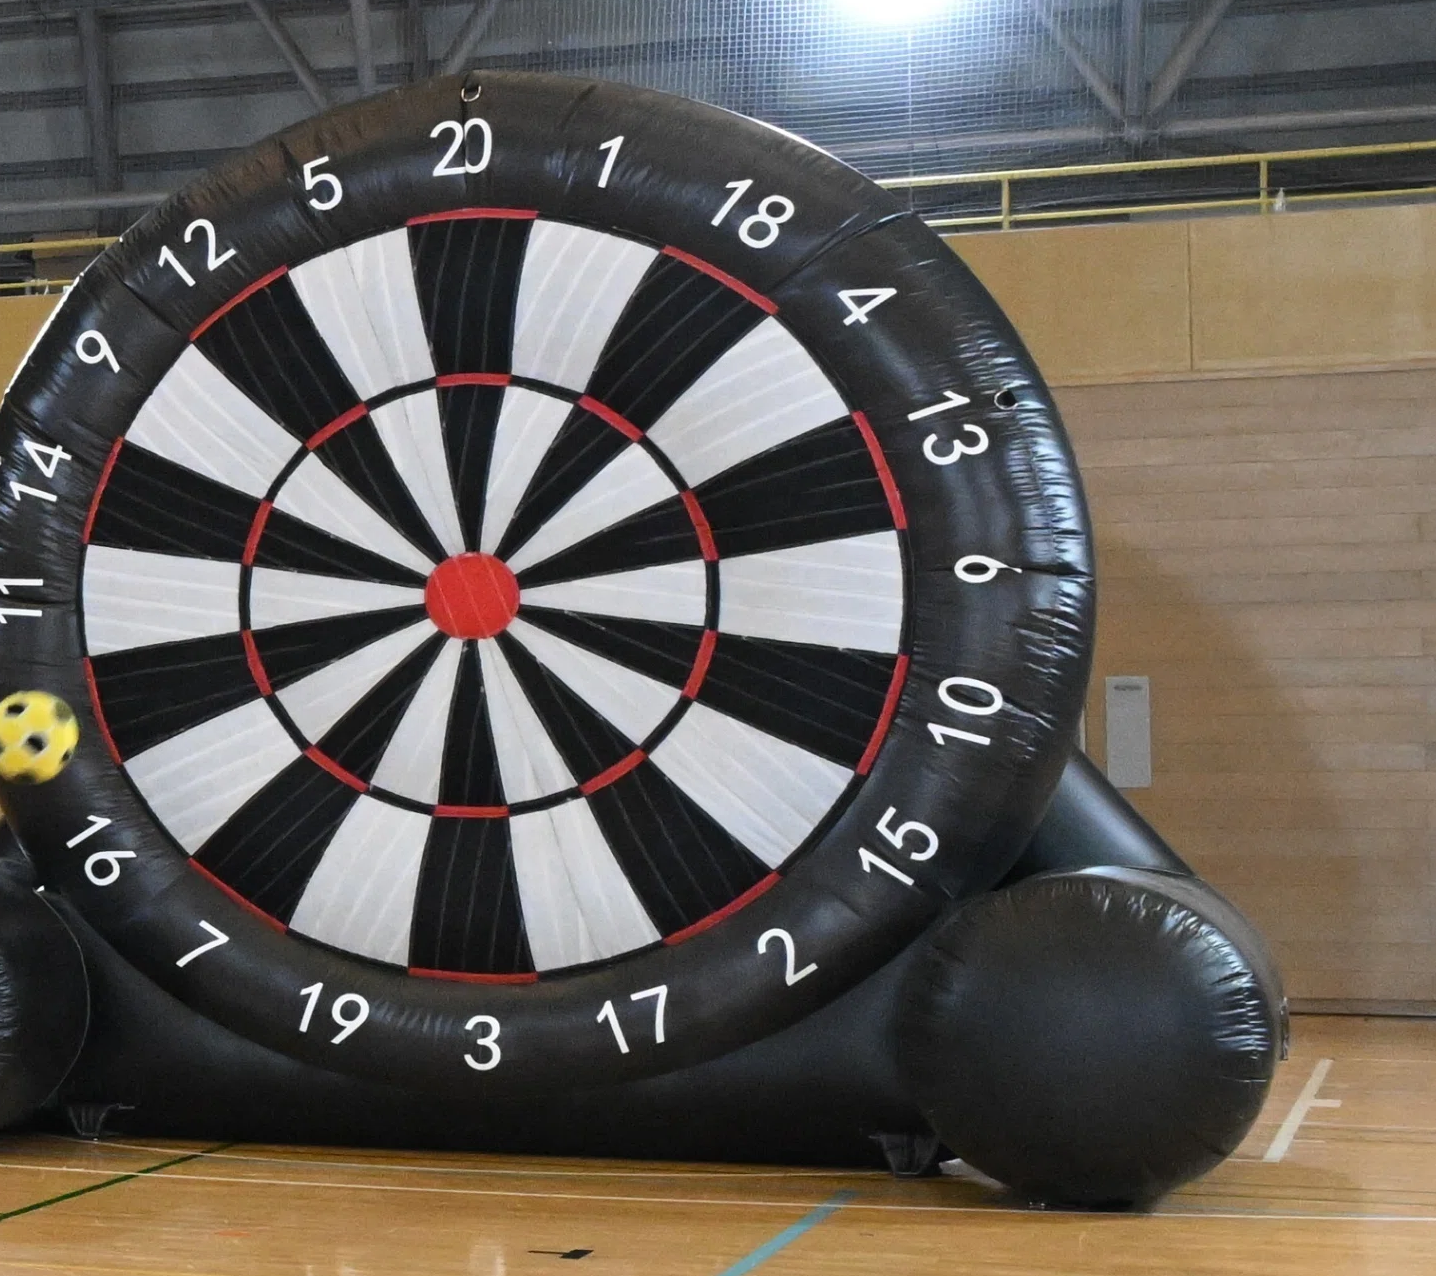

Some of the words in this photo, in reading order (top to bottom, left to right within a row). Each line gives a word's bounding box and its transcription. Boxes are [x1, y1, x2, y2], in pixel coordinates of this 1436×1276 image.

[429, 116, 493, 178] 20
[596, 134, 626, 190] 1
[302, 154, 344, 212] 5
[710, 177, 796, 250] 18
[156, 217, 238, 288] 12
[836, 286, 899, 327] 4
[74, 328, 124, 375] 9
[906, 389, 990, 467] 13
[8, 438, 73, 503] 14
[926, 675, 1006, 747] 10
[65, 813, 138, 887] 16
[857, 805, 940, 887] 15
[175, 919, 231, 969] 7
[756, 927, 819, 987] 2
[298, 981, 371, 1046] 19
[463, 1014, 502, 1072] 3
[595, 983, 669, 1055] 17
